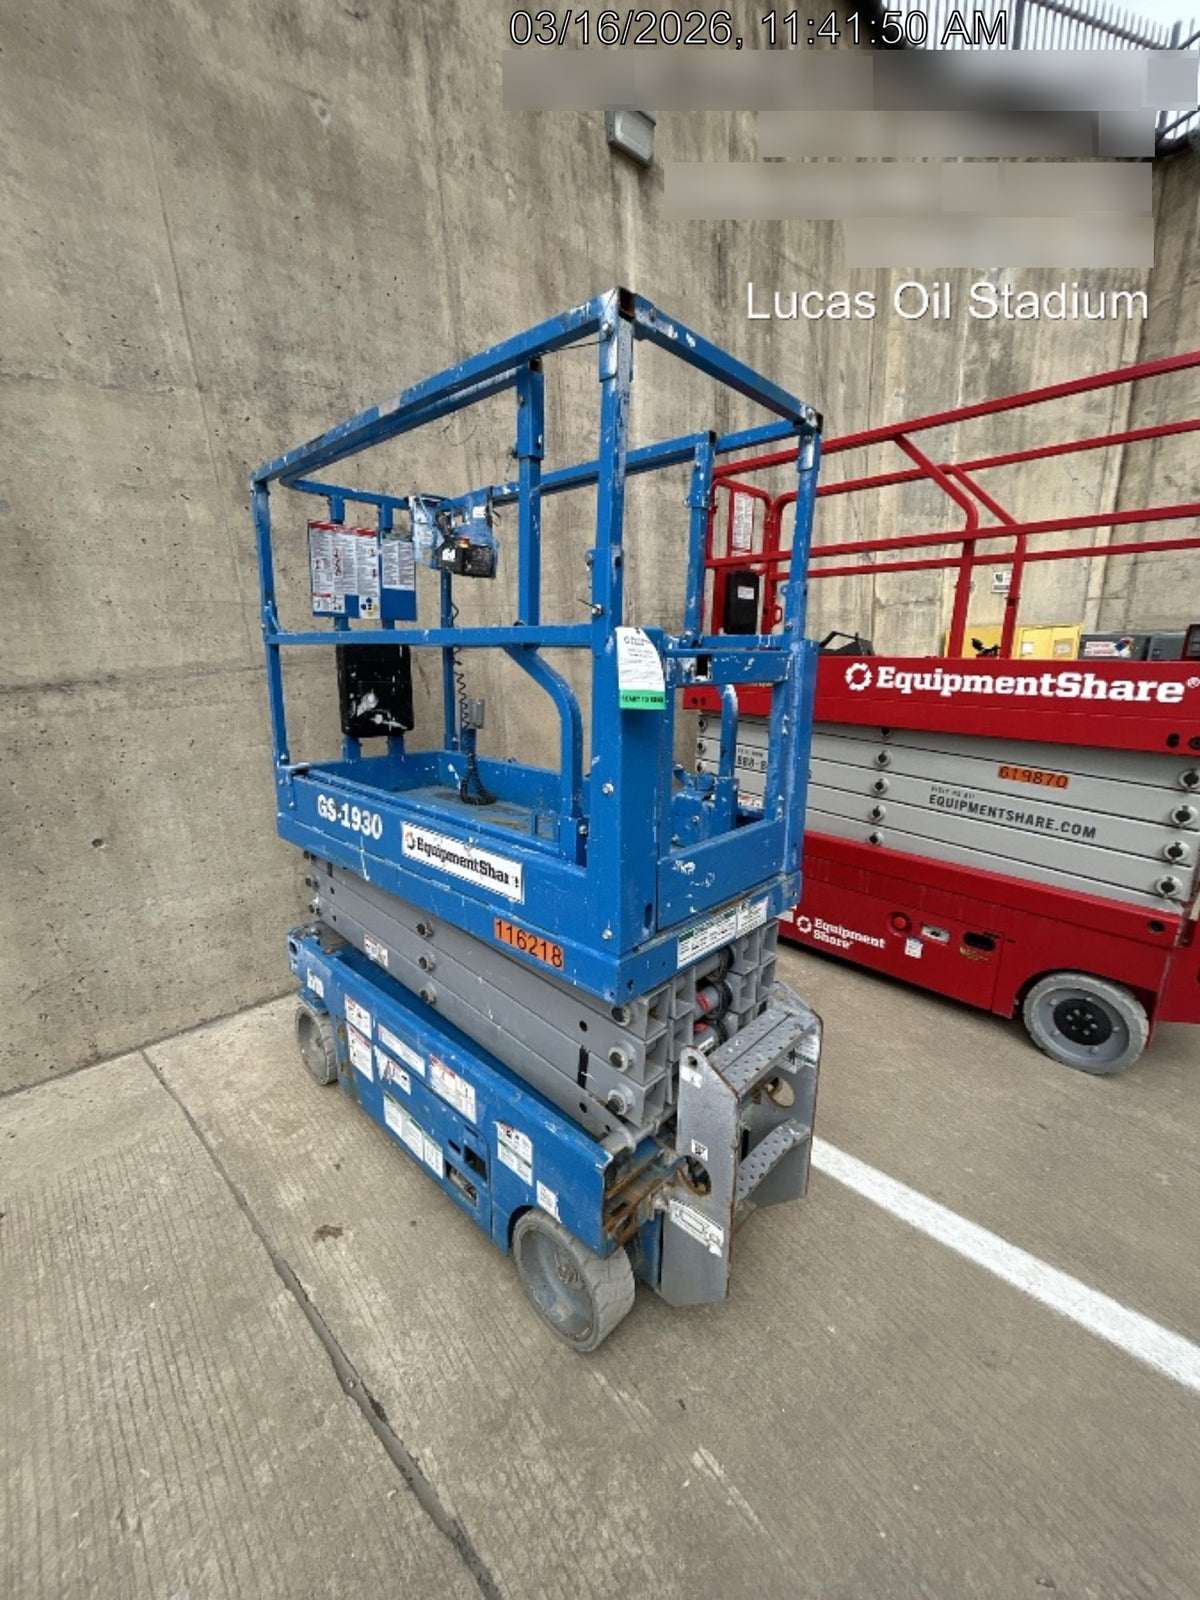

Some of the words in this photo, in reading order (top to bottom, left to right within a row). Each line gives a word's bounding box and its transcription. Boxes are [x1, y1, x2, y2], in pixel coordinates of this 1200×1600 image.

[317, 793, 384, 841] GS-1930
[929, 794, 1096, 839] EQUIPMENTSHARE.COM
[495, 920, 564, 969] 116218
[813, 917, 886, 949] Equipment
[813, 929, 851, 949] Share
